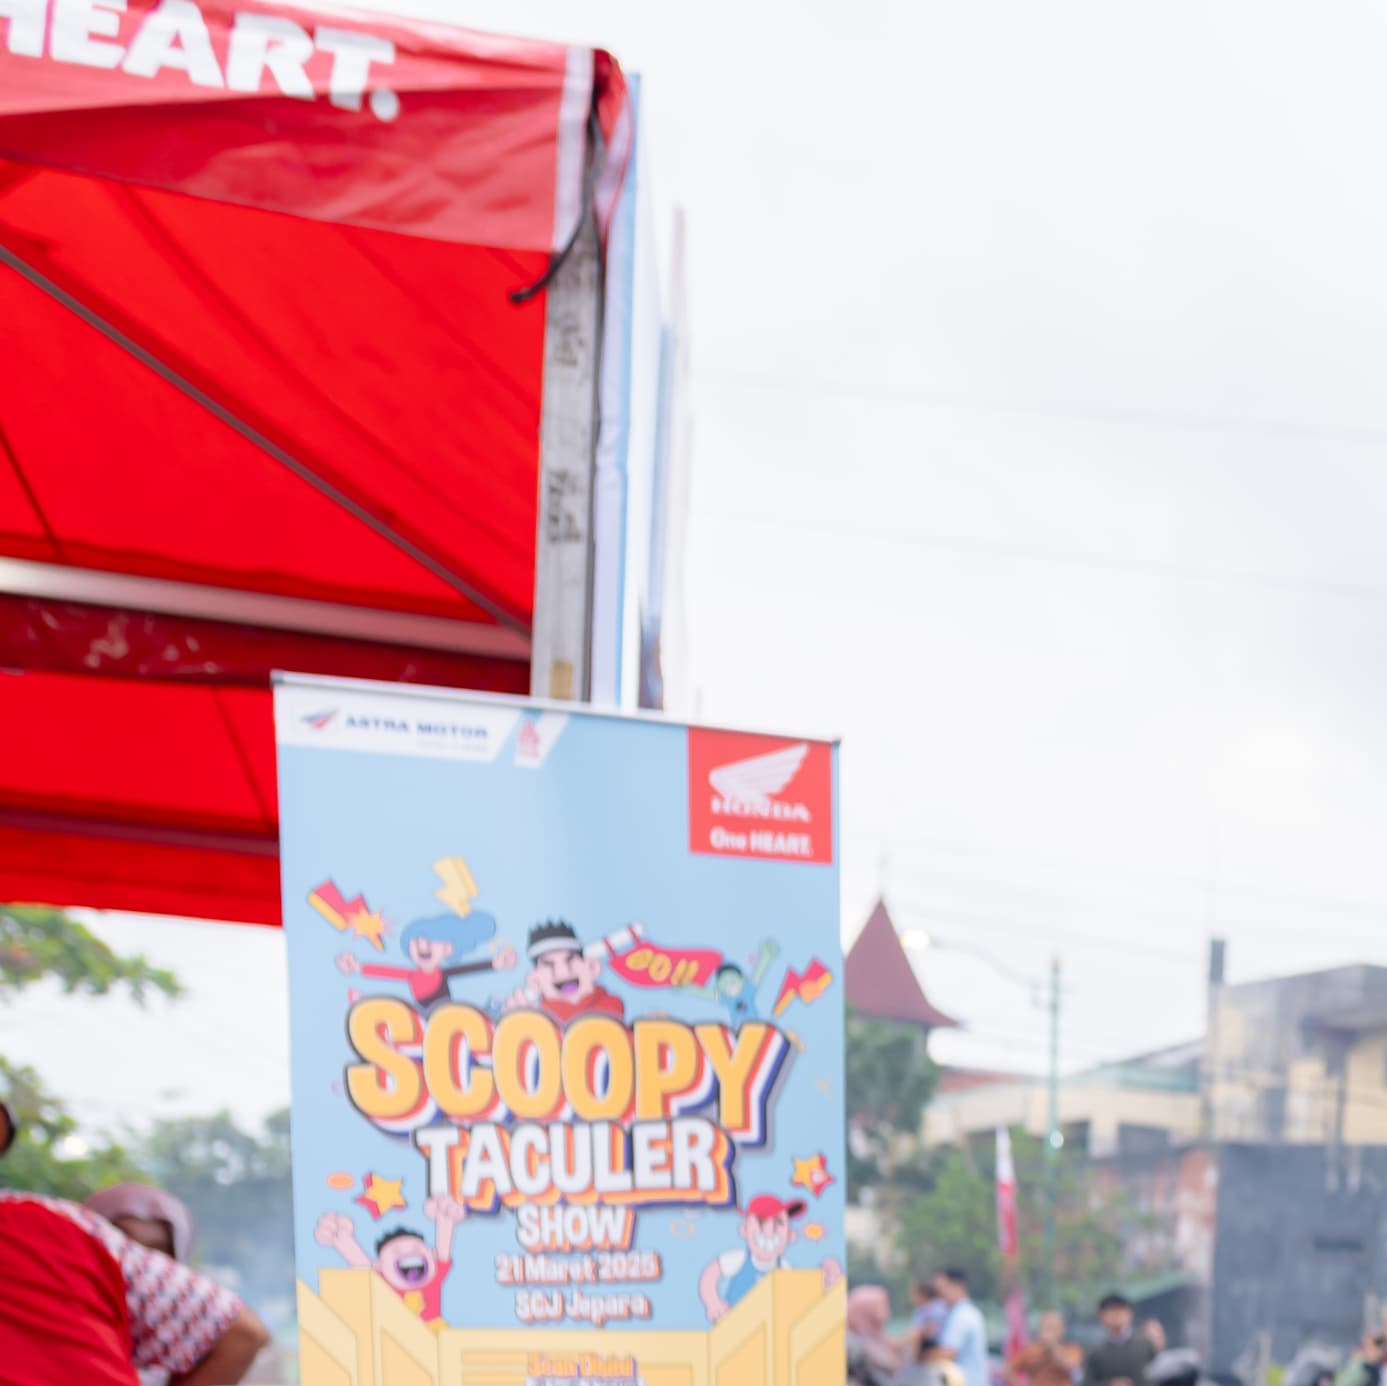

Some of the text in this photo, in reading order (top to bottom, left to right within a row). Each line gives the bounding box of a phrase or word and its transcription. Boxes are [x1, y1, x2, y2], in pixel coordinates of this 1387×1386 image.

[710, 797, 811, 823] HONDA
[346, 994, 786, 1146] SCOOPY
[413, 1117, 730, 1206] TACULER
[517, 1204, 634, 1250] SHOW
[496, 1250, 662, 1284] 21 Maret 2025
[515, 1290, 565, 1323] SCJ
